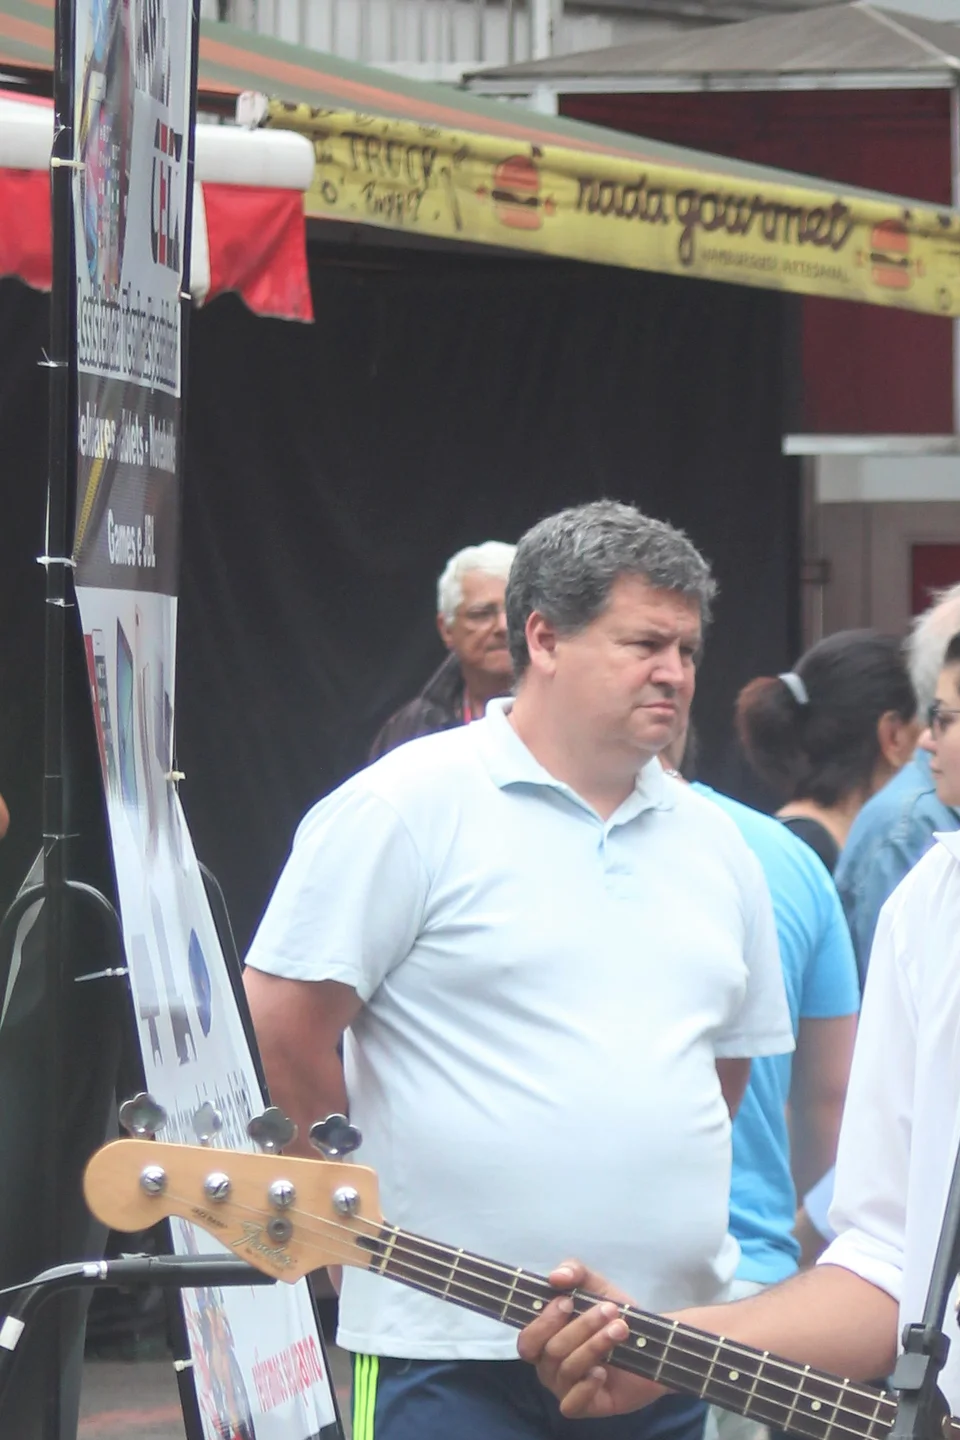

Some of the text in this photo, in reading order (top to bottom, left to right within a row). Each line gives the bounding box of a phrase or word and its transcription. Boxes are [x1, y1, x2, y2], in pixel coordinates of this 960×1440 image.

[576, 174, 853, 267] nada gourmet
[107, 508, 136, 565] Games
[137, 526, 143, 568] e
[231, 1221, 292, 1265] Fender
